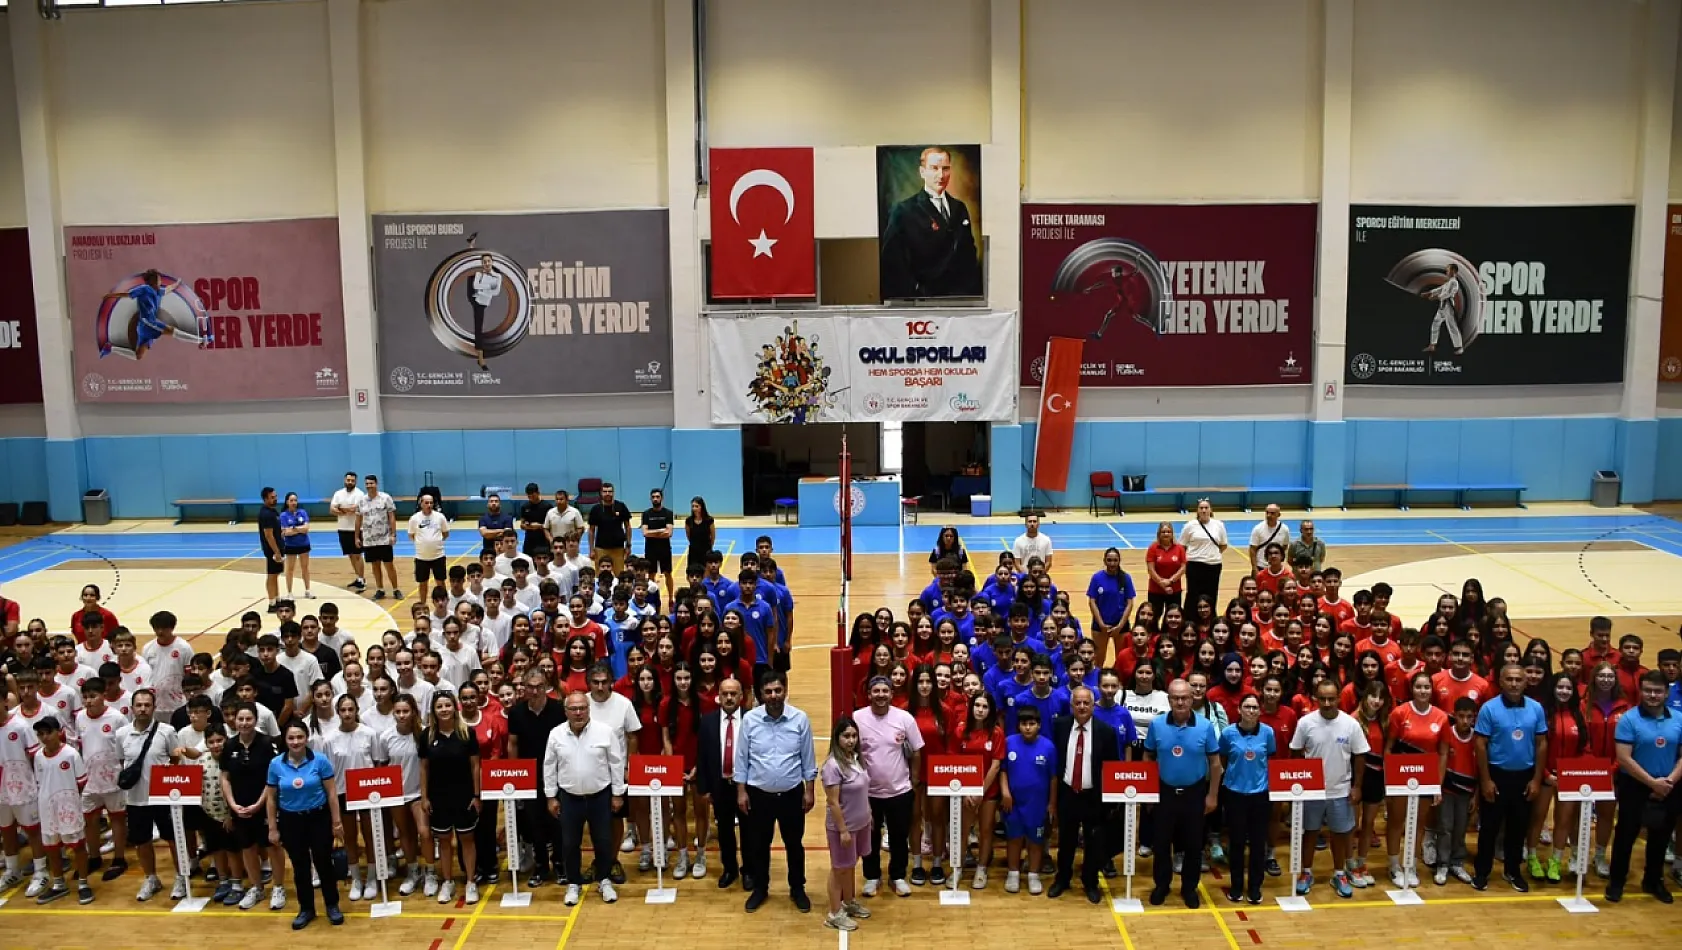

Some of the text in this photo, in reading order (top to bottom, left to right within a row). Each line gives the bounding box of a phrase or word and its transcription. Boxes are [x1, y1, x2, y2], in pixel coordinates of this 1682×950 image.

[1031, 214, 1105, 226] YETENEK TARAMASI
[1356, 215, 1460, 229] SPORCU EĞİTİM MERKEZLERİ
[384, 223, 464, 236] MİLLİ SPORCU BURSU
[1031, 227, 1075, 240] PROJESİ İLE
[72, 232, 156, 246] ANADOLU YILDIZLAR LİGİ
[1356, 230, 1367, 242] İLE
[384, 237, 428, 249] PROJESİ İLE
[73, 248, 102, 260] PROJESİ
[527, 260, 611, 299] EĞİTİM
[1159, 260, 1265, 294] YETENEK
[1479, 261, 1546, 296] SPOR
[194, 276, 260, 311] SPOR
[528, 301, 650, 335] HER YERDE
[1159, 299, 1289, 334] HER YERDE
[1477, 299, 1604, 334] HER YERDE
[198, 312, 322, 349] HER YERDE
[859, 345, 987, 364] OKUL SPORLARI
[868, 367, 978, 377] HEM SPORDA HEM OKULDA
[904, 377, 943, 388] BAŞARI
[1325, 384, 1335, 396] A
[358, 391, 366, 403] B
[490, 768, 528, 778] KÜTAHYA
[644, 764, 667, 774] İZMİR
[933, 764, 977, 774] ESKİŞEHİR
[1279, 769, 1313, 780] BİLECİK
[1399, 764, 1424, 773] AYDIN
[162, 774, 190, 784] MUĞLA
[359, 776, 392, 787] MANİSA
[1114, 771, 1147, 781] DENİZLİ
